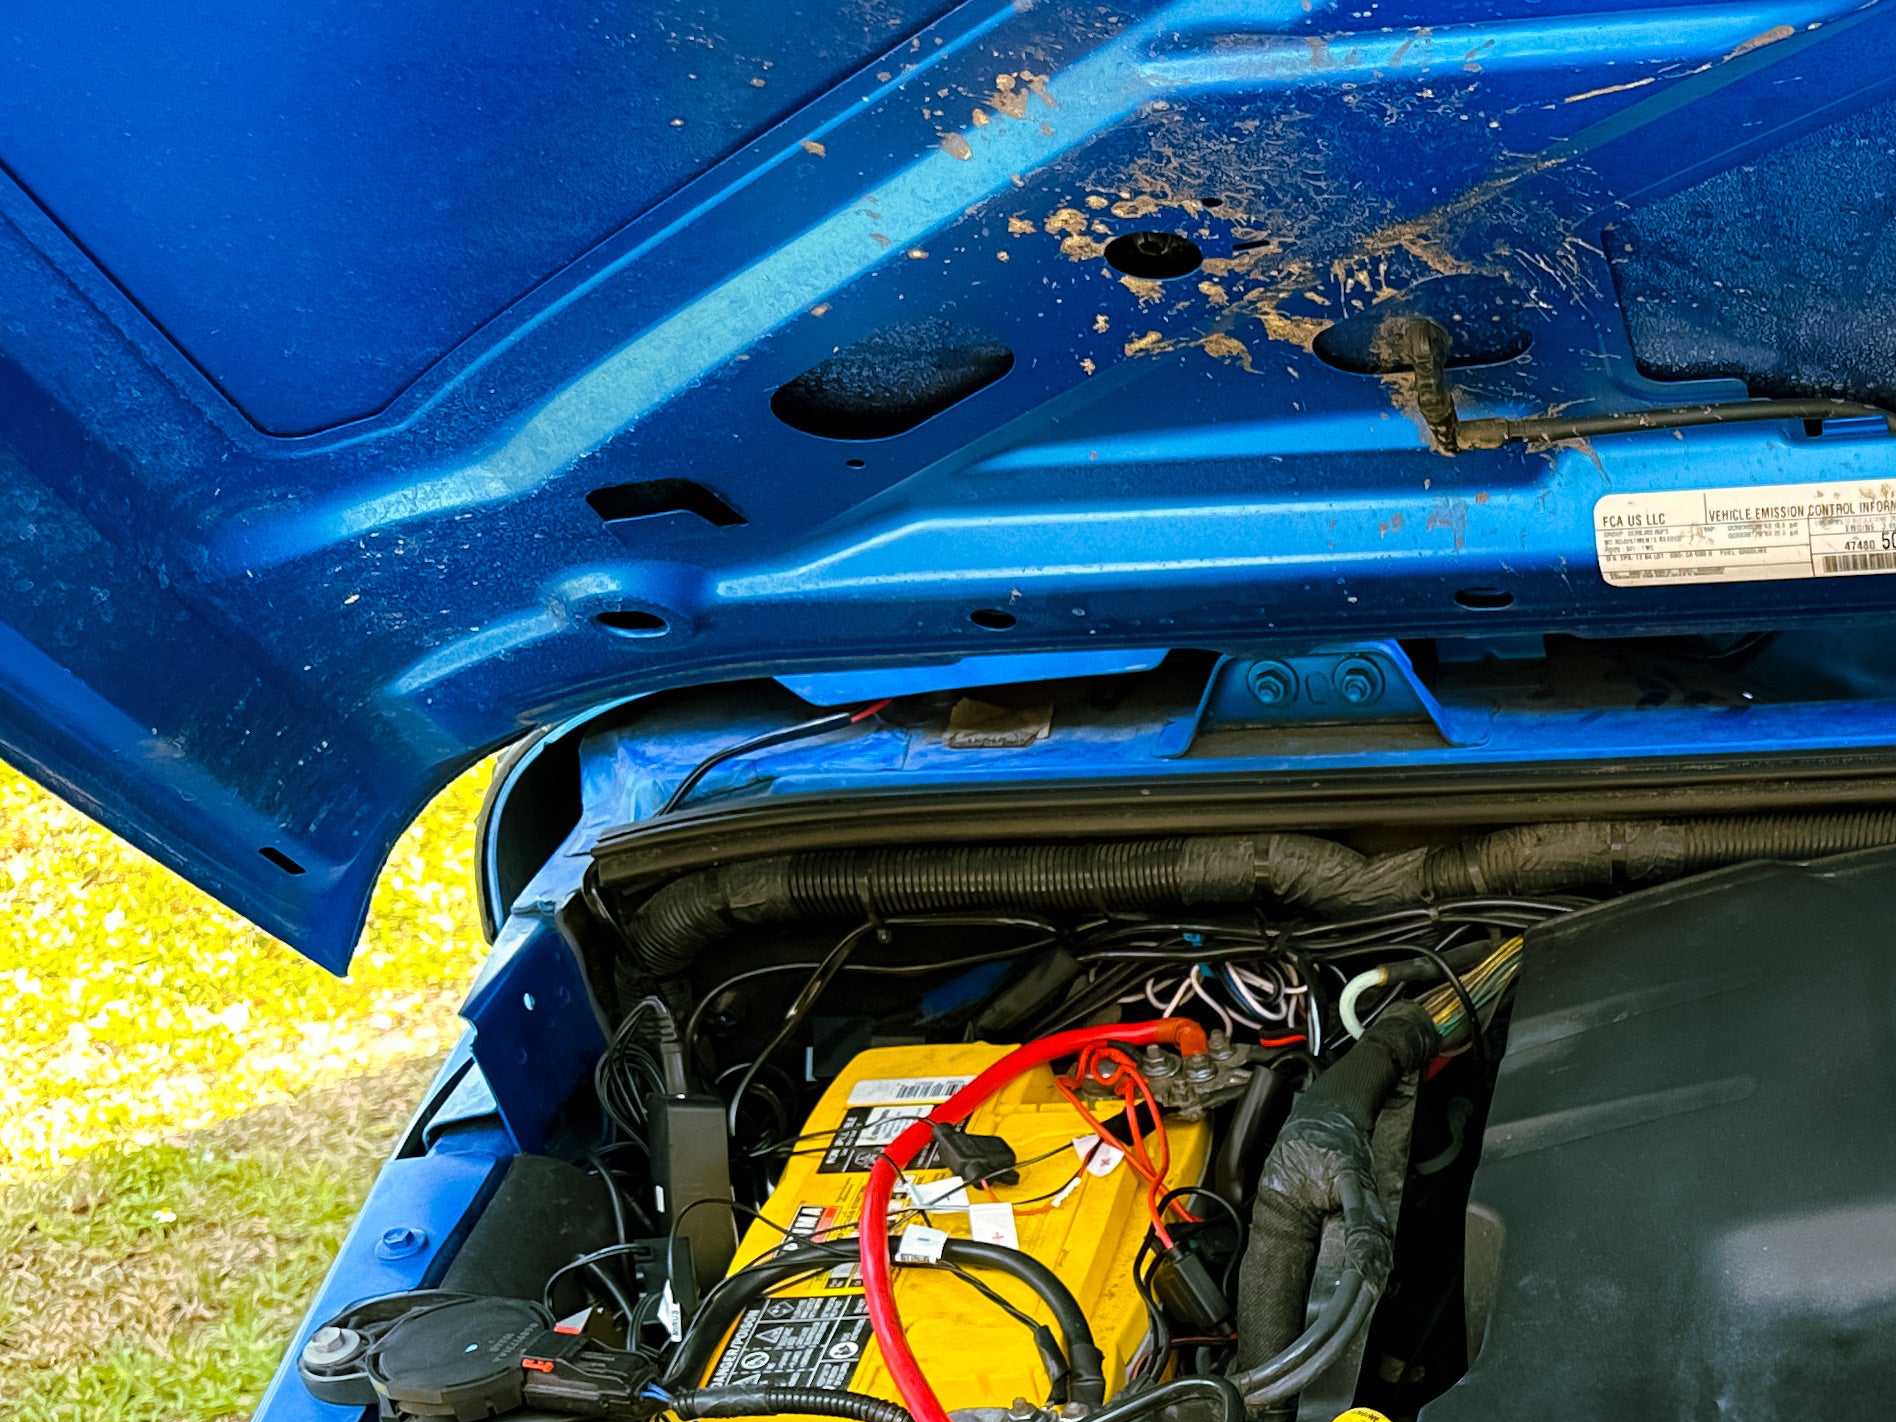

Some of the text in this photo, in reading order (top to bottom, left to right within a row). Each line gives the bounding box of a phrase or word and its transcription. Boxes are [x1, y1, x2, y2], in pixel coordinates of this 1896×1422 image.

[1603, 512, 1666, 528] FCA US LLC
[1709, 507, 1752, 522] VEHICLE
[1755, 504, 1805, 519] EMISSION
[1808, 502, 1855, 517] CONTROL
